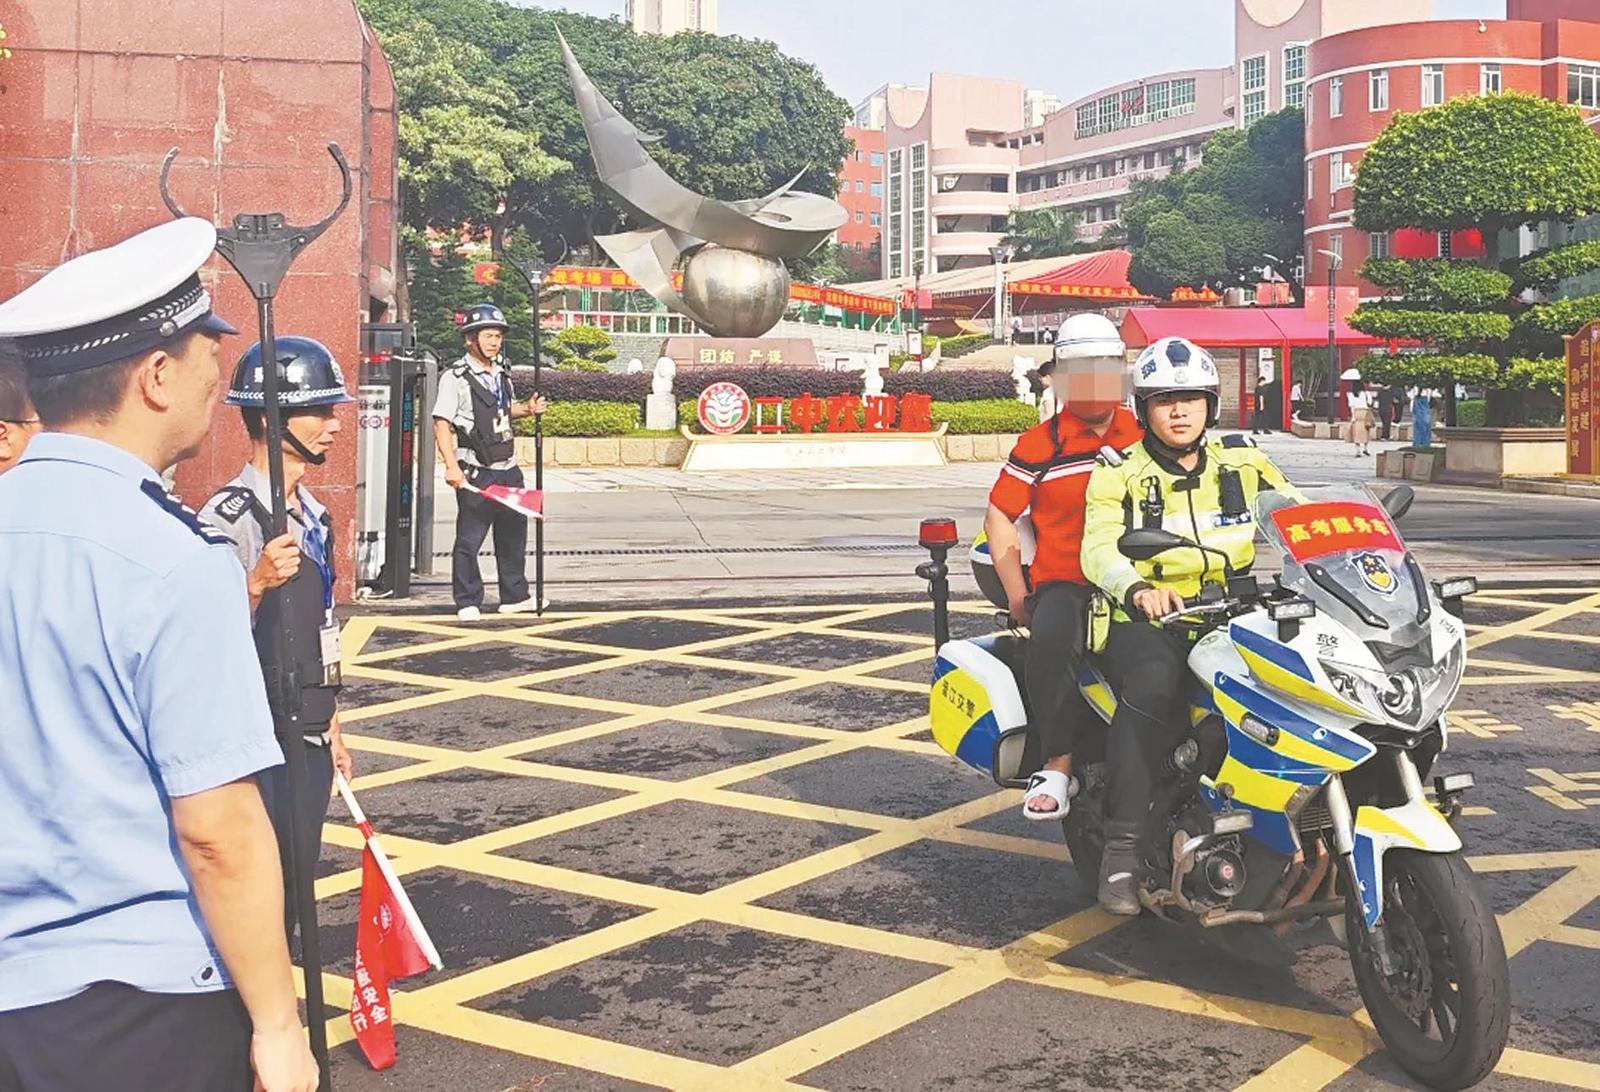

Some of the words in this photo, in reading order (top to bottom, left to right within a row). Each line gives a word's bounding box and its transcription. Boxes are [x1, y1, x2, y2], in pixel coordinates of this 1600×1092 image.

[700, 348, 735, 364] 团结
[1286, 516, 1390, 543] 高考服务车
[1316, 632, 1338, 657] 警
